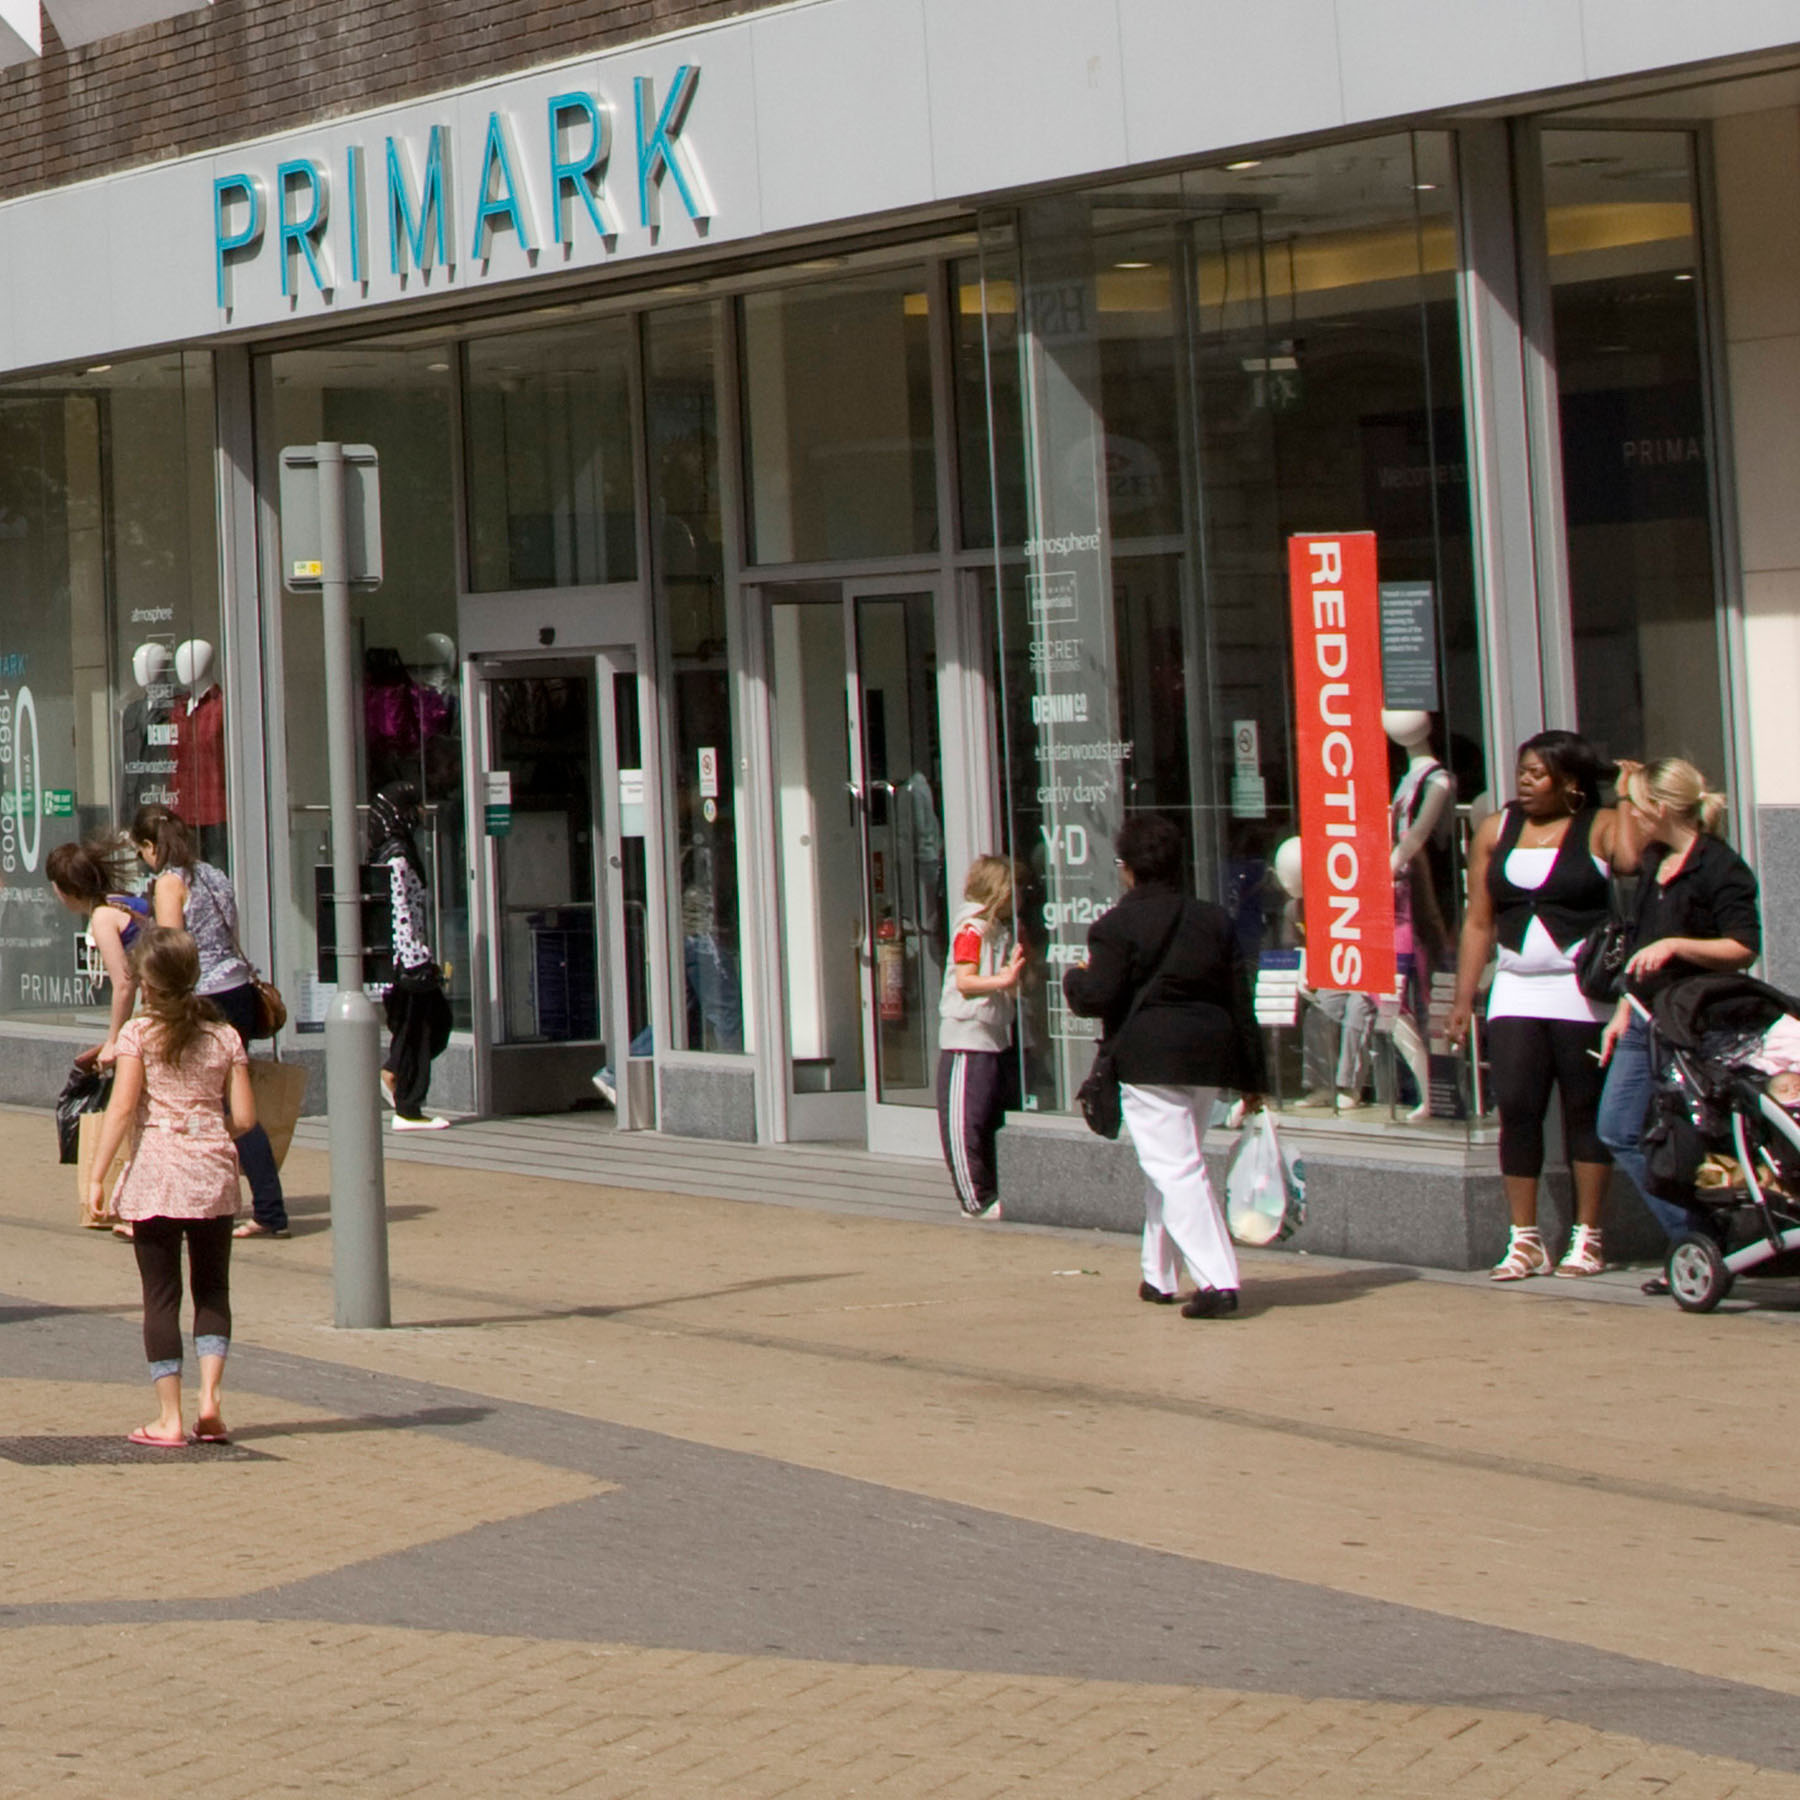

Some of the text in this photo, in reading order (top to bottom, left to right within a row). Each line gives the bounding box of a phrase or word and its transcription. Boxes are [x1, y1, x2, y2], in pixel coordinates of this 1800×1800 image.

[214, 65, 716, 310] PRIMARK
[1024, 532, 1099, 557] atmosphere
[1029, 639, 1080, 662] SECRET
[1032, 694, 1074, 725] DENIM
[1309, 542, 1362, 985] REDUCTIONS
[1037, 776, 1106, 811] early days
[21, 974, 97, 1005] PRIMARK
[1060, 1016, 1094, 1032] Home
